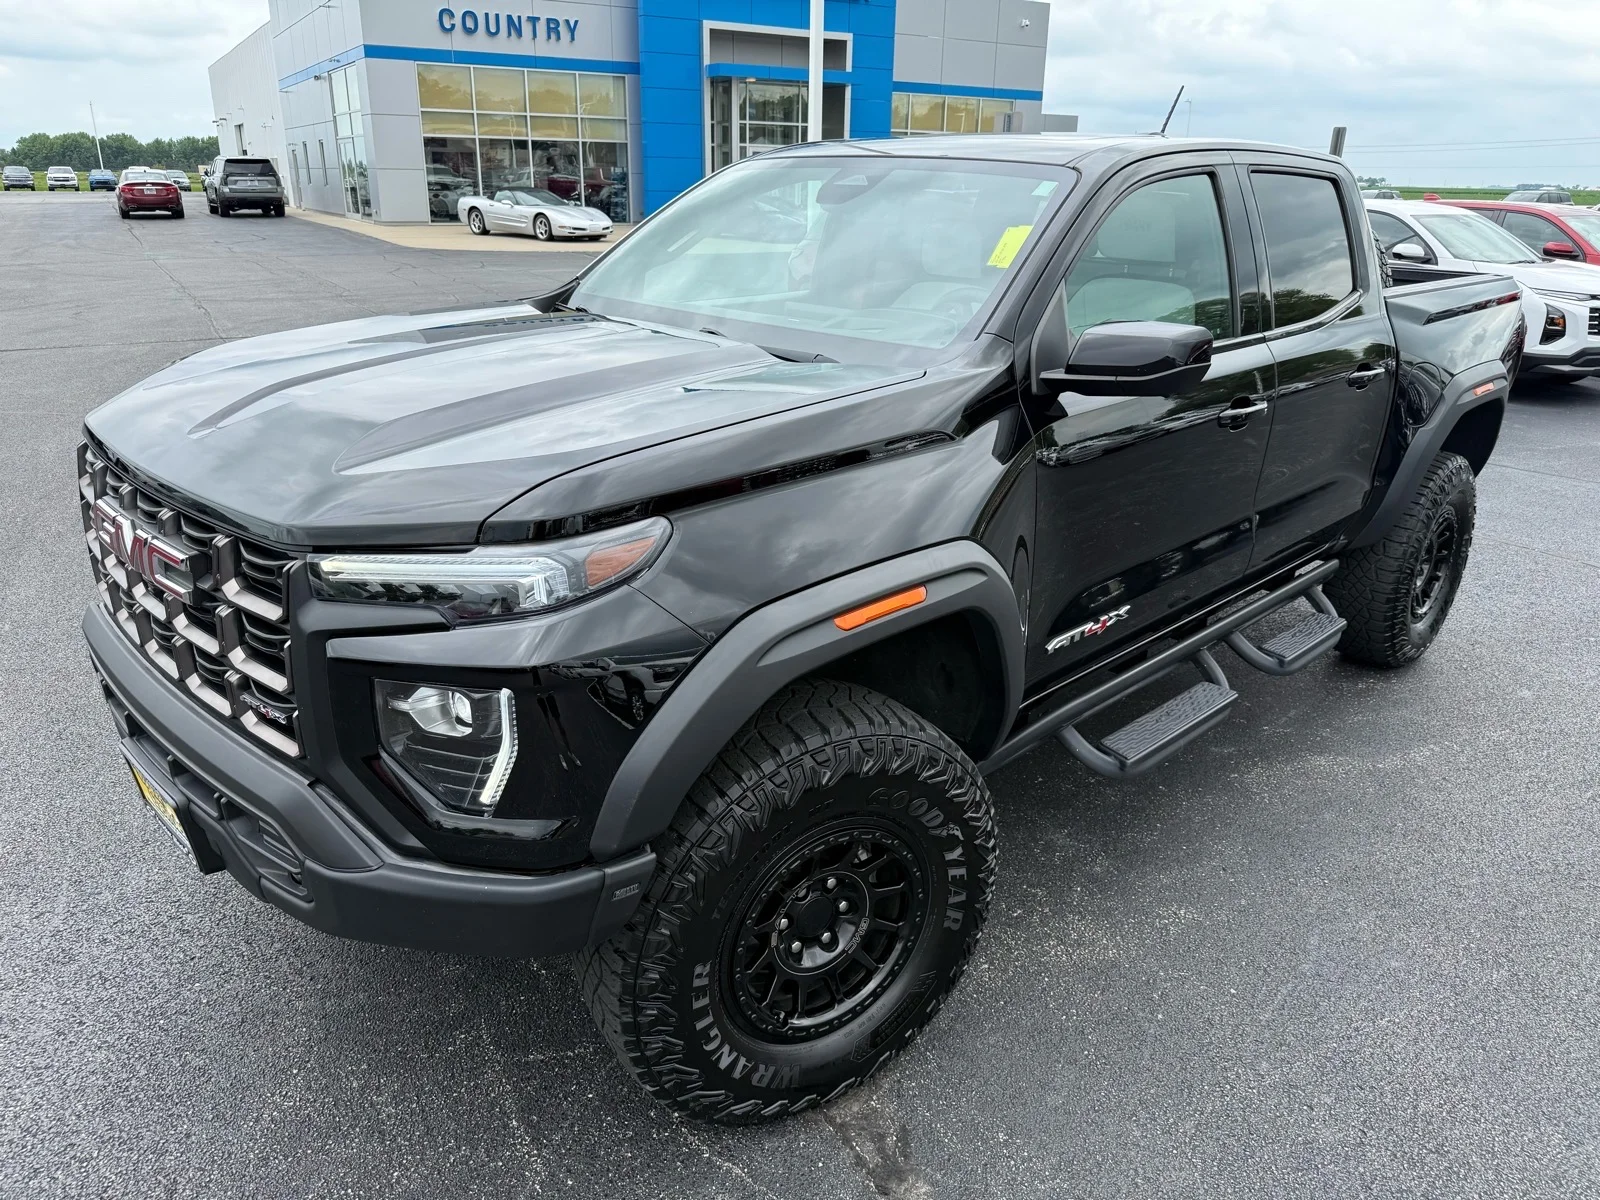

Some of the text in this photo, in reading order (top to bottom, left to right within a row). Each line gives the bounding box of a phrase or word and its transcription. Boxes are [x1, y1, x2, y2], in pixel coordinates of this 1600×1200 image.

[438, 8, 580, 42] COUNTRY
[94, 499, 193, 605] GMC
[1045, 605, 1131, 655] AT4X
[845, 917, 870, 954] GMC
[691, 960, 800, 1089] WRANGLER
